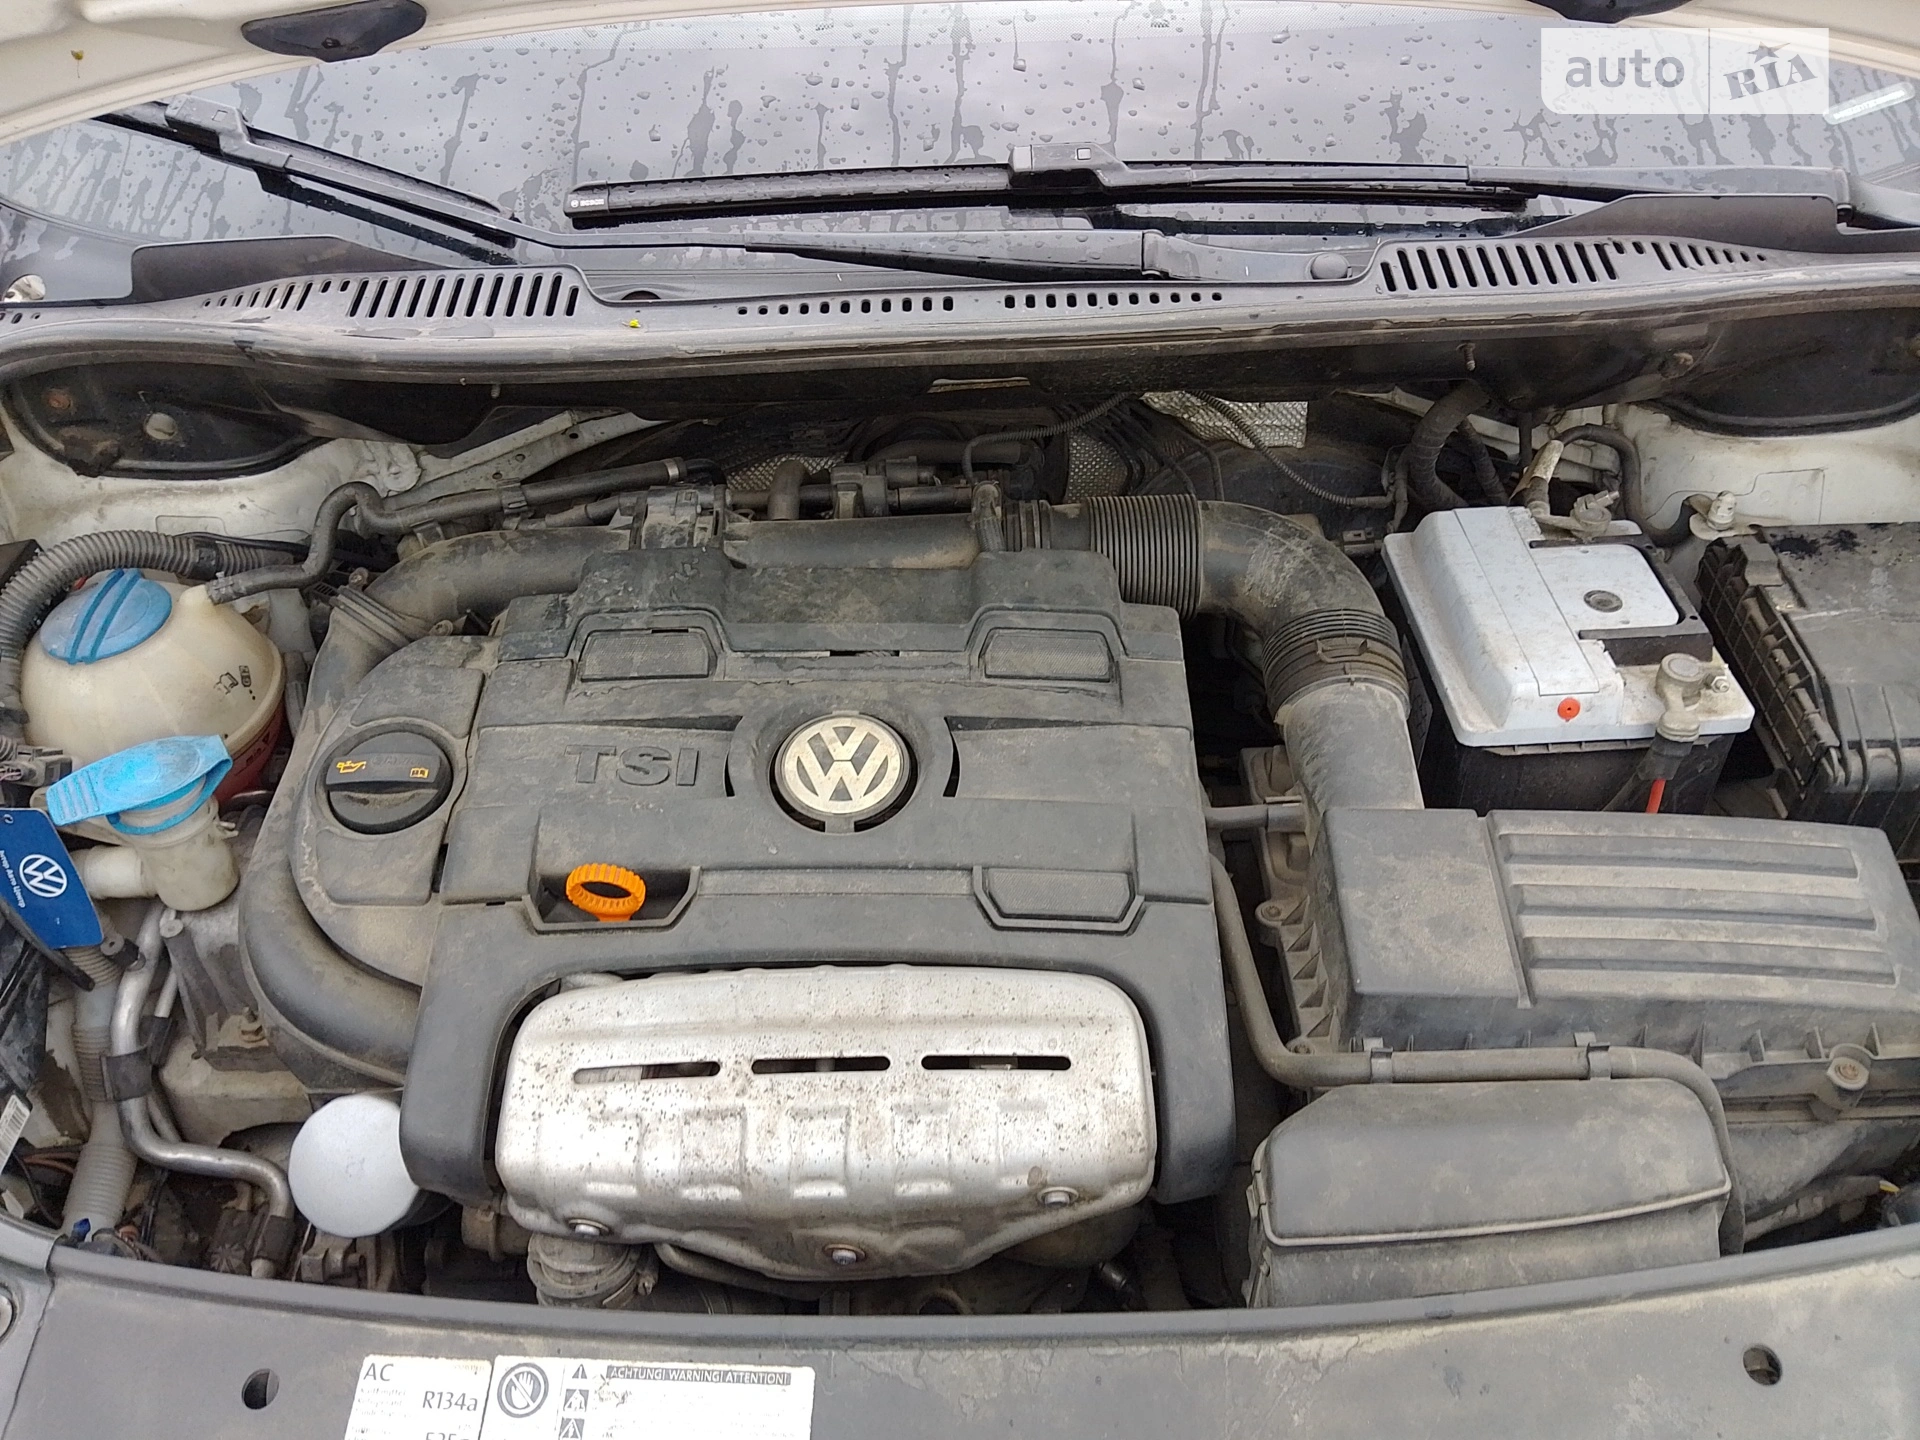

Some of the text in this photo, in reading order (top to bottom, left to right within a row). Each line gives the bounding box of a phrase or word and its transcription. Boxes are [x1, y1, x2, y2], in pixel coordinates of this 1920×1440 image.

[564, 744, 699, 786] TSI
[363, 1362, 394, 1381] AC
[422, 1390, 479, 1412] R134a
